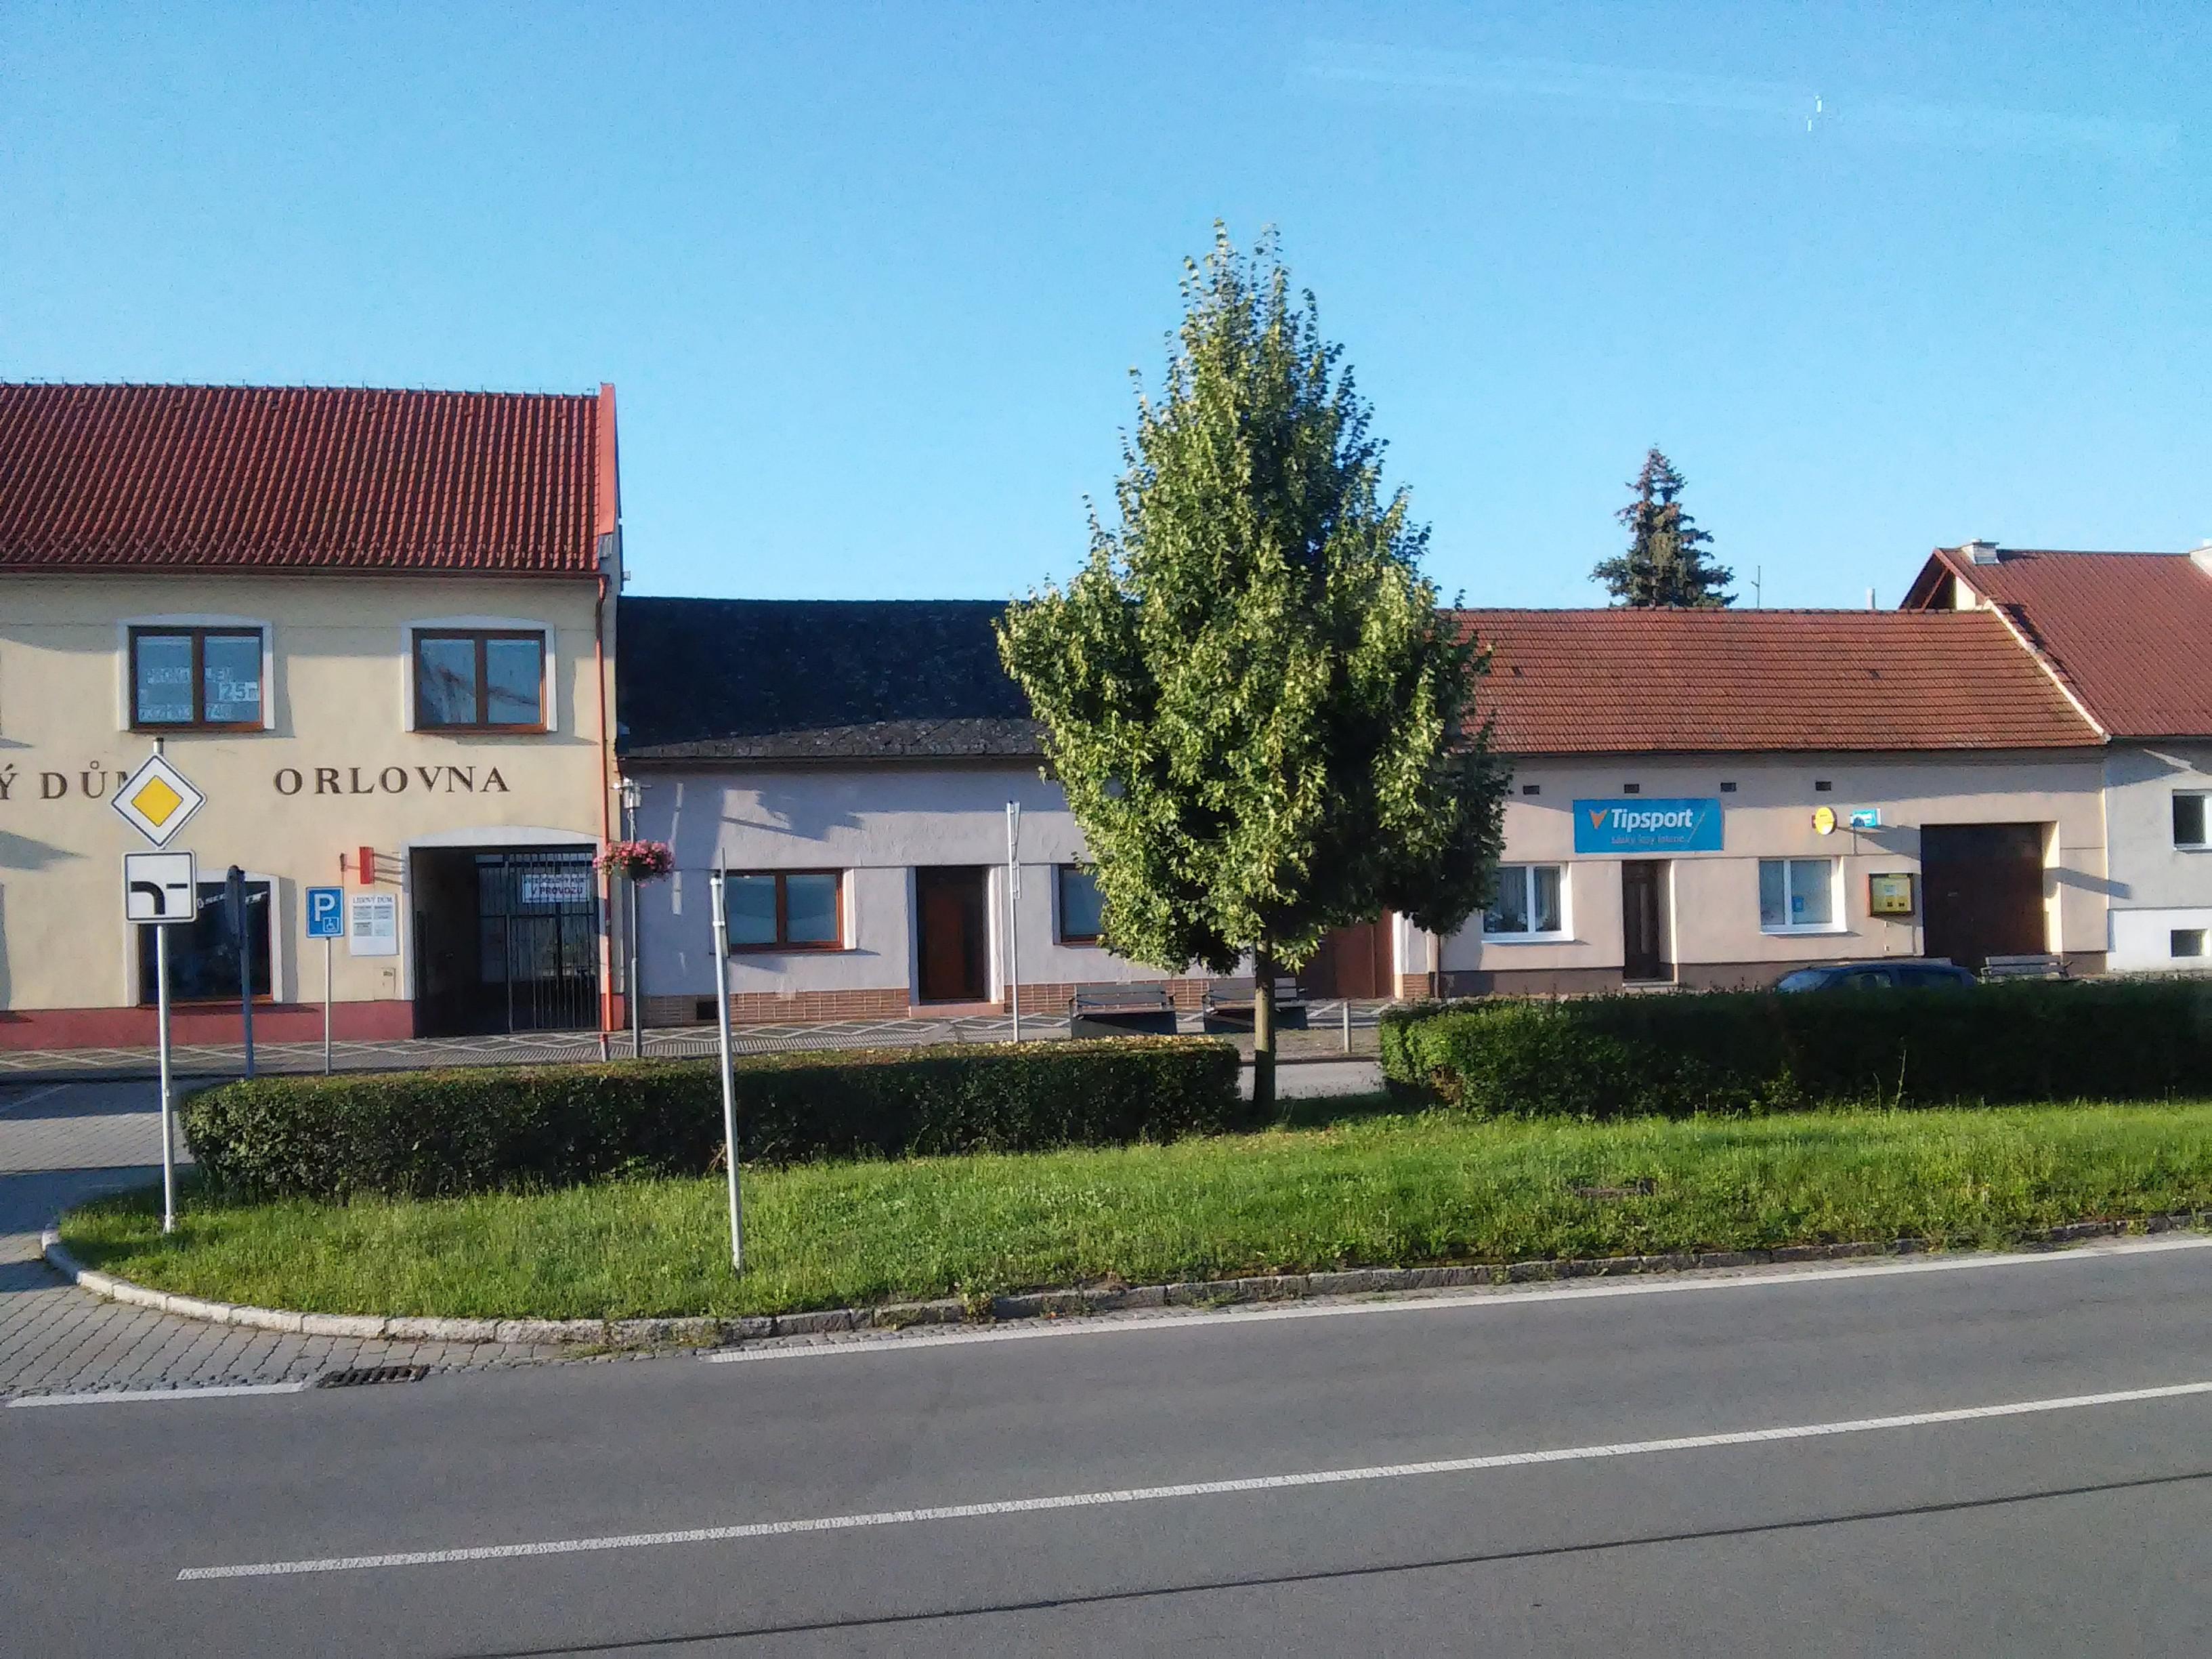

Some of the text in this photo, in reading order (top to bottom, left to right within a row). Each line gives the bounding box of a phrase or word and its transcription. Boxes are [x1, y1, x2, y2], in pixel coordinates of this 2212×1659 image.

[272, 765, 511, 796] ORLOVNA
[1611, 808, 1693, 833] Tipsport
[539, 886, 583, 894] PROVOZU
[314, 893, 336, 922] P
